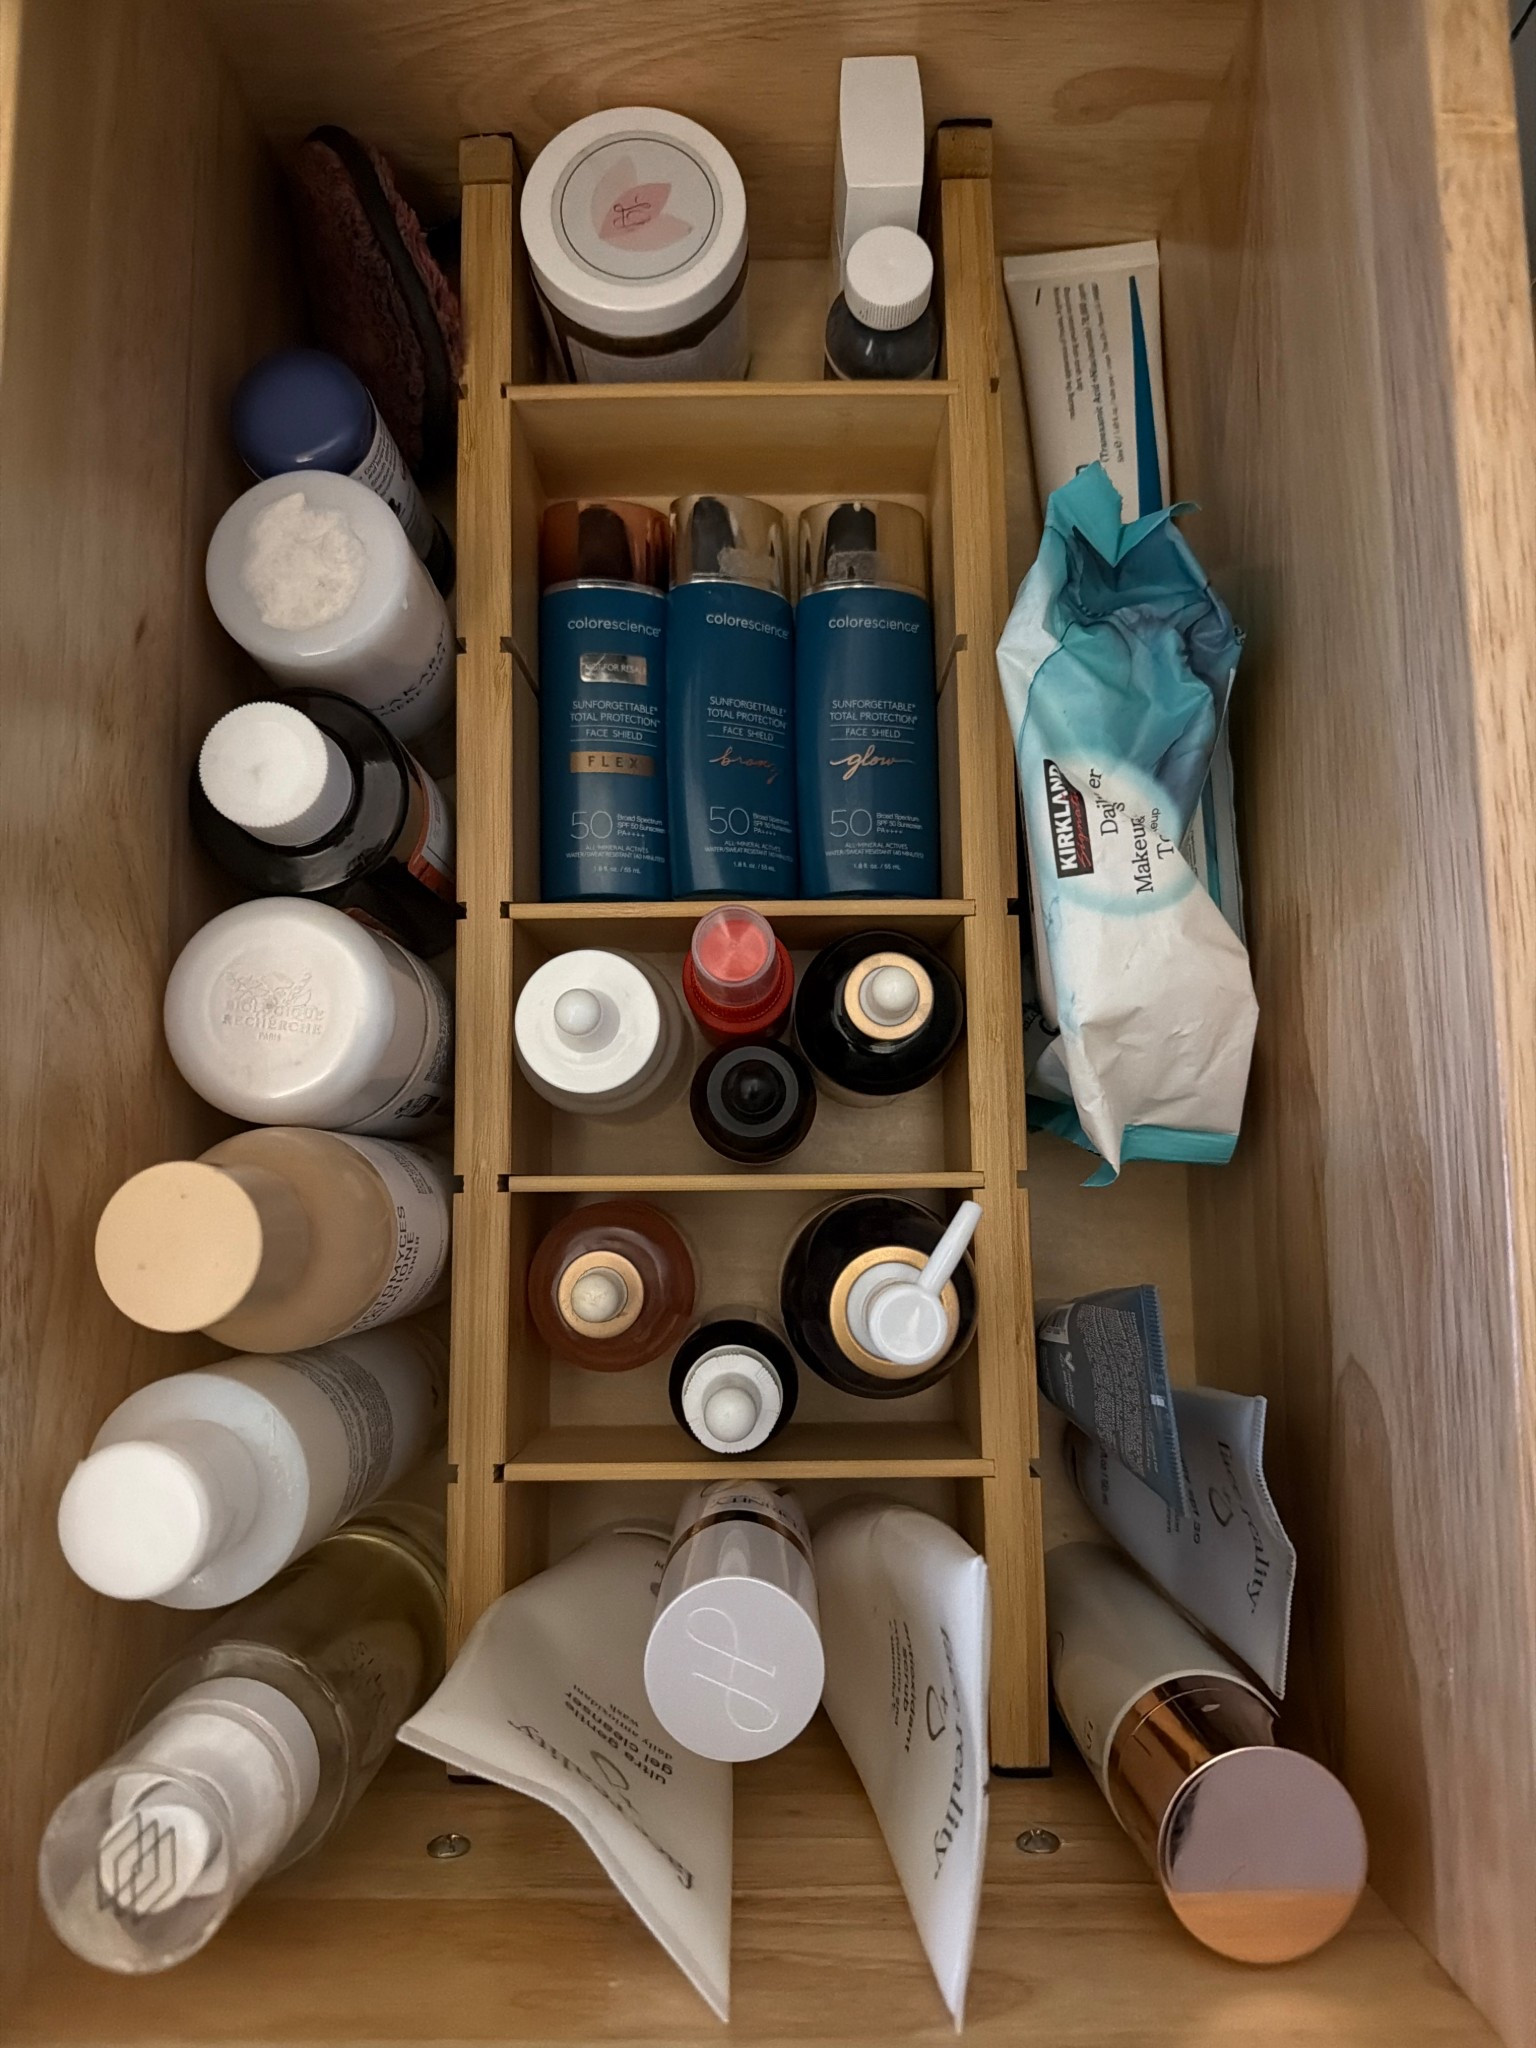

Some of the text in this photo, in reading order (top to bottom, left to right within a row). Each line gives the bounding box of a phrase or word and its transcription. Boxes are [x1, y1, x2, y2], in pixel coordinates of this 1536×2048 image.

[568, 617, 661, 637] colorescience
[706, 612, 790, 639] colorescience
[828, 615, 919, 633] colorescience
[573, 700, 657, 715] SUNFORGETTABLE
[707, 707, 786, 729] TOTAL PROTECTION
[830, 712, 917, 724] TOTAL PROTECTION
[832, 699, 915, 712] SUNFORGETTABLE
[570, 712, 660, 727] TOTAL PROTECTION
[845, 728, 901, 738] FACE SHIELD
[585, 728, 643, 741] FACE SHIELD
[722, 726, 774, 742] FACE SHIELD
[588, 756, 639, 769] FLEX
[829, 744, 915, 781] glow
[570, 811, 613, 839] 50
[708, 806, 750, 836] 50
[830, 809, 873, 837] 50
[1049, 764, 1078, 871] KIRKLAND
[1241, 1508, 1270, 1614] reality
[902, 1620, 917, 1753] antioxidant
[573, 1684, 673, 1760] daily antioxidant
[609, 1703, 640, 1728] wash
[564, 1691, 673, 1776] gel cleanser
[565, 1701, 667, 1785] ultra gentle
[507, 1719, 624, 1814] reality
[934, 1723, 964, 1880] reality
